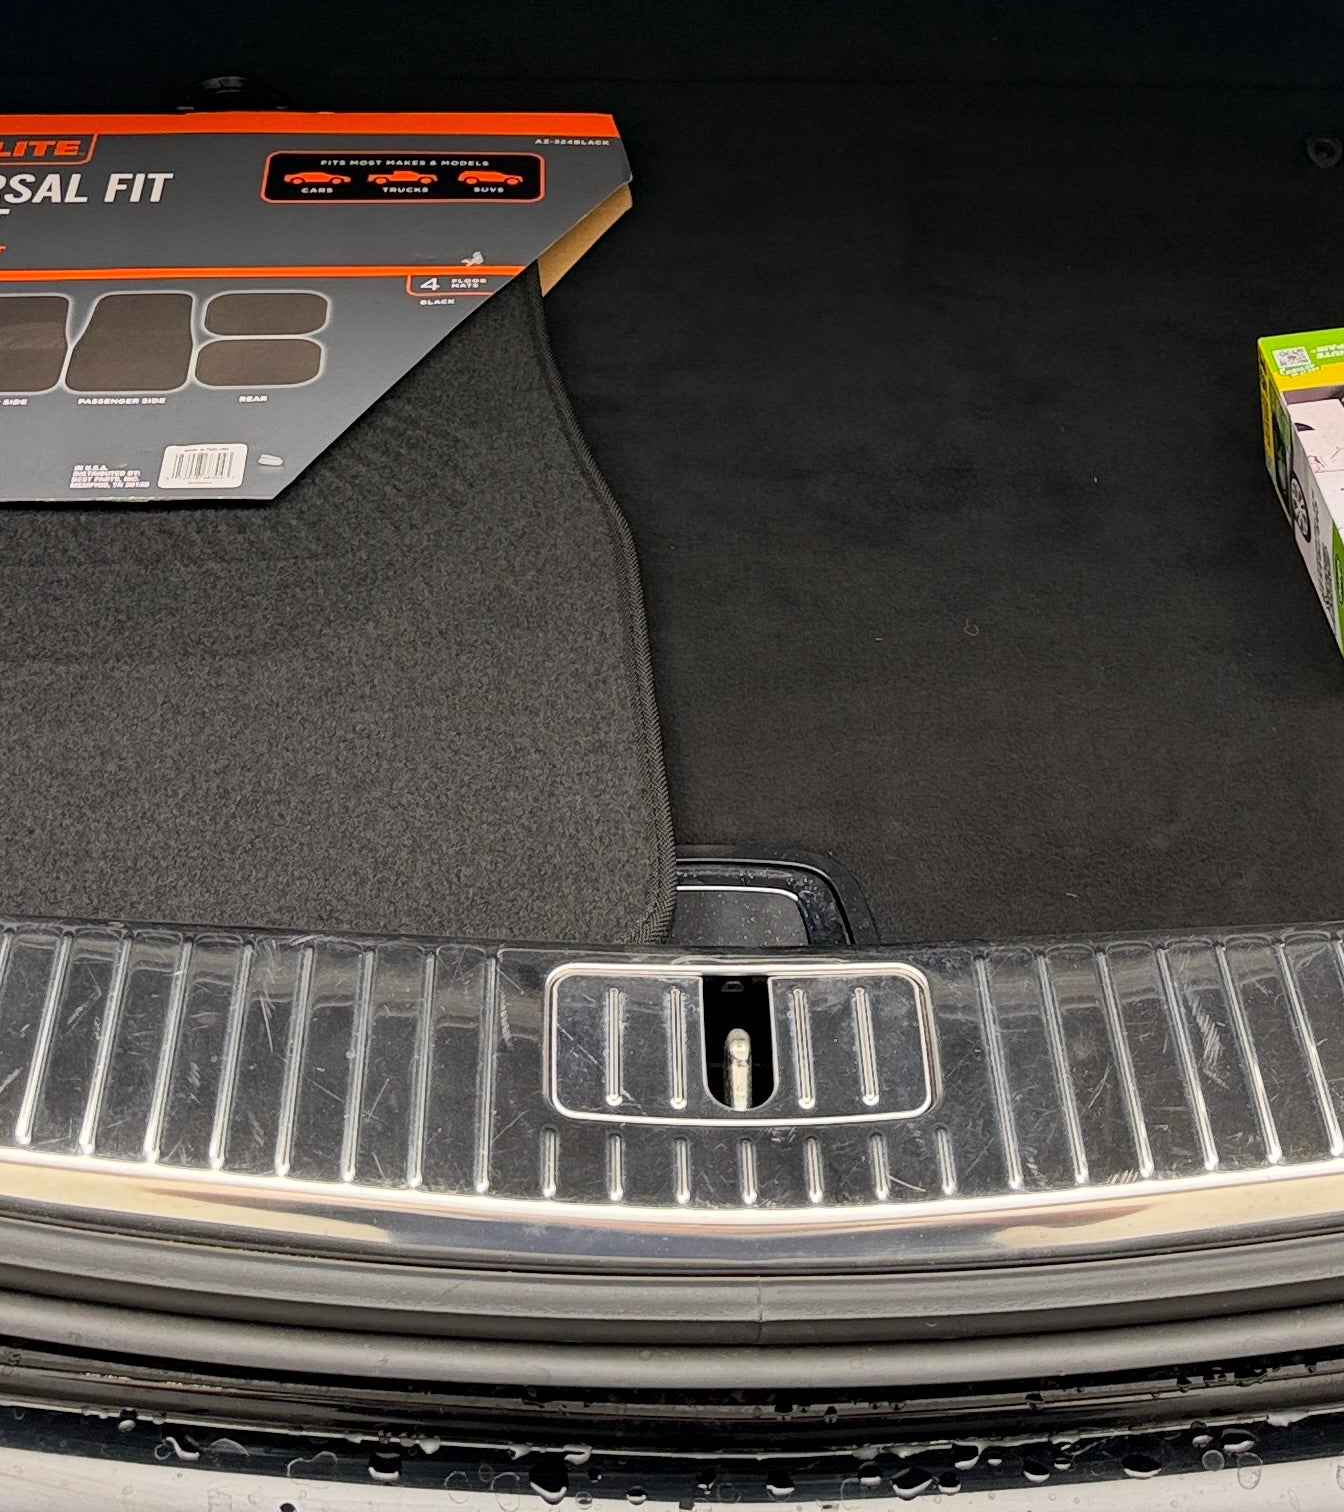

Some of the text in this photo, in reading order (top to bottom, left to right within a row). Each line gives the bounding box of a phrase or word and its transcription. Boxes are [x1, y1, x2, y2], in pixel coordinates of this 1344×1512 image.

[104, 173, 174, 202] FIT
[420, 277, 440, 291] 4
[239, 395, 267, 403] REAR
